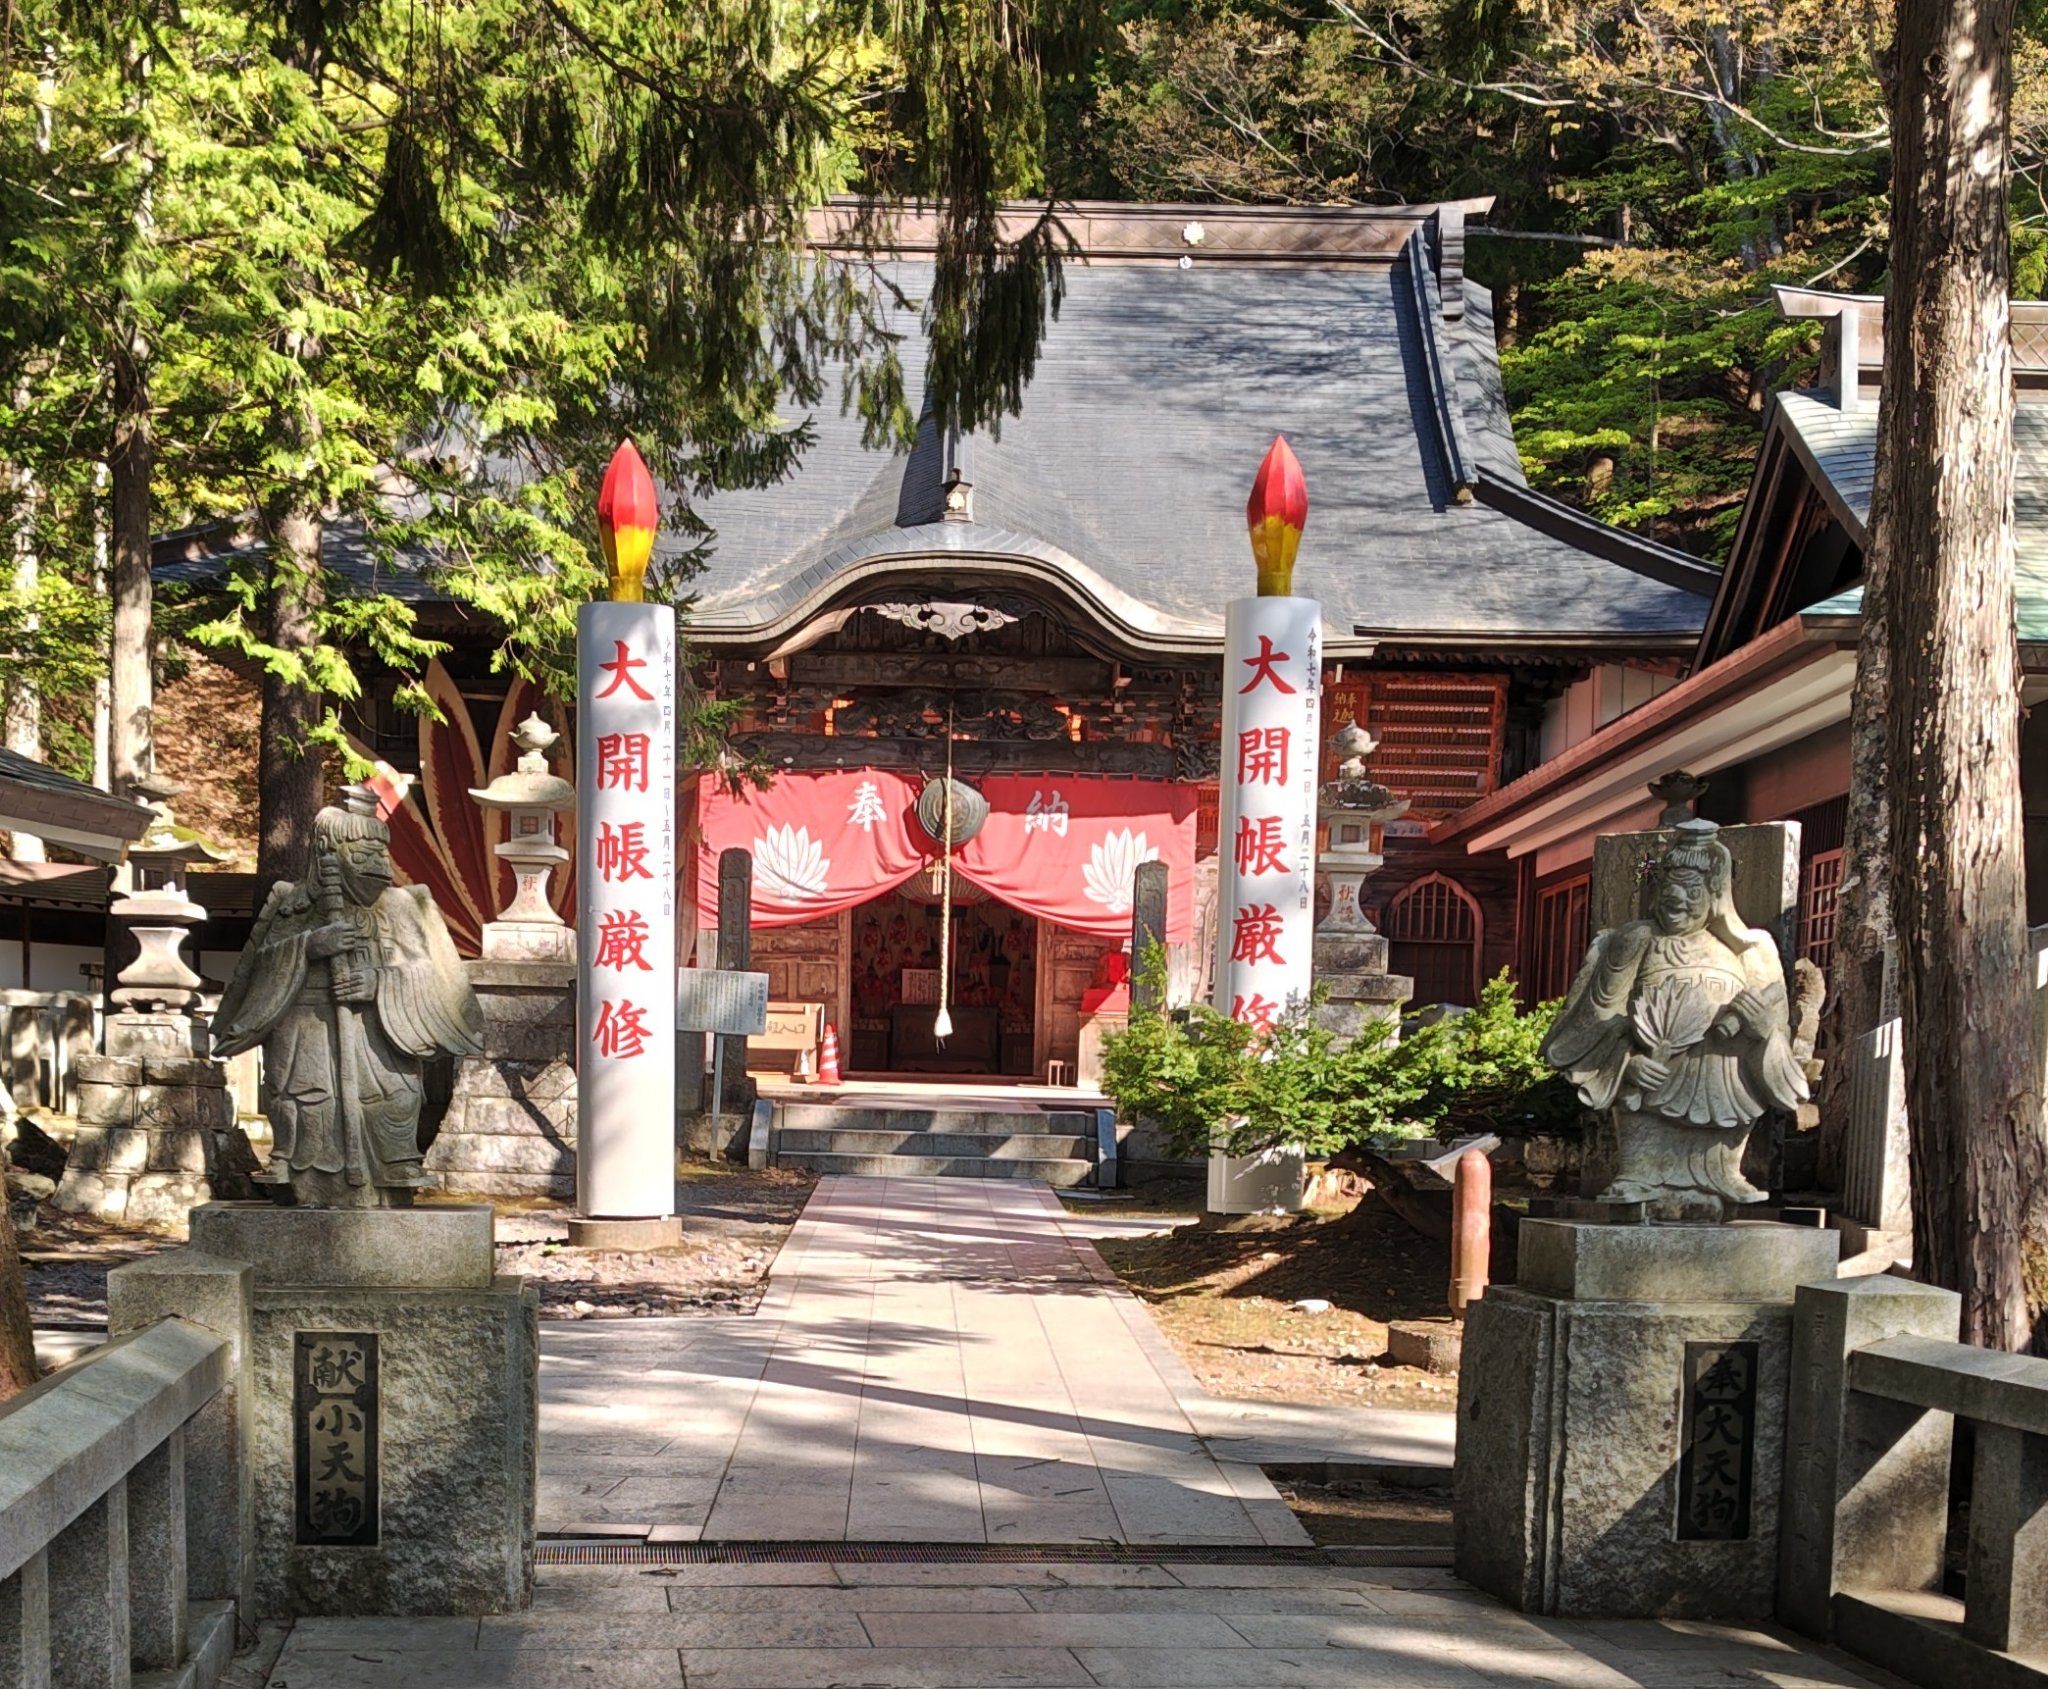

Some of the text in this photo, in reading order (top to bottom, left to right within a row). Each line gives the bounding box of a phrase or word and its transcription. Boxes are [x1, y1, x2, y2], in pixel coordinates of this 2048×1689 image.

[592, 640, 655, 1060] 大開帳厳修
[847, 782, 1069, 837] 奉 納
[314, 1347, 365, 1531] 献 小天狗
[1695, 1355, 1741, 1528] 奉 大天狗
